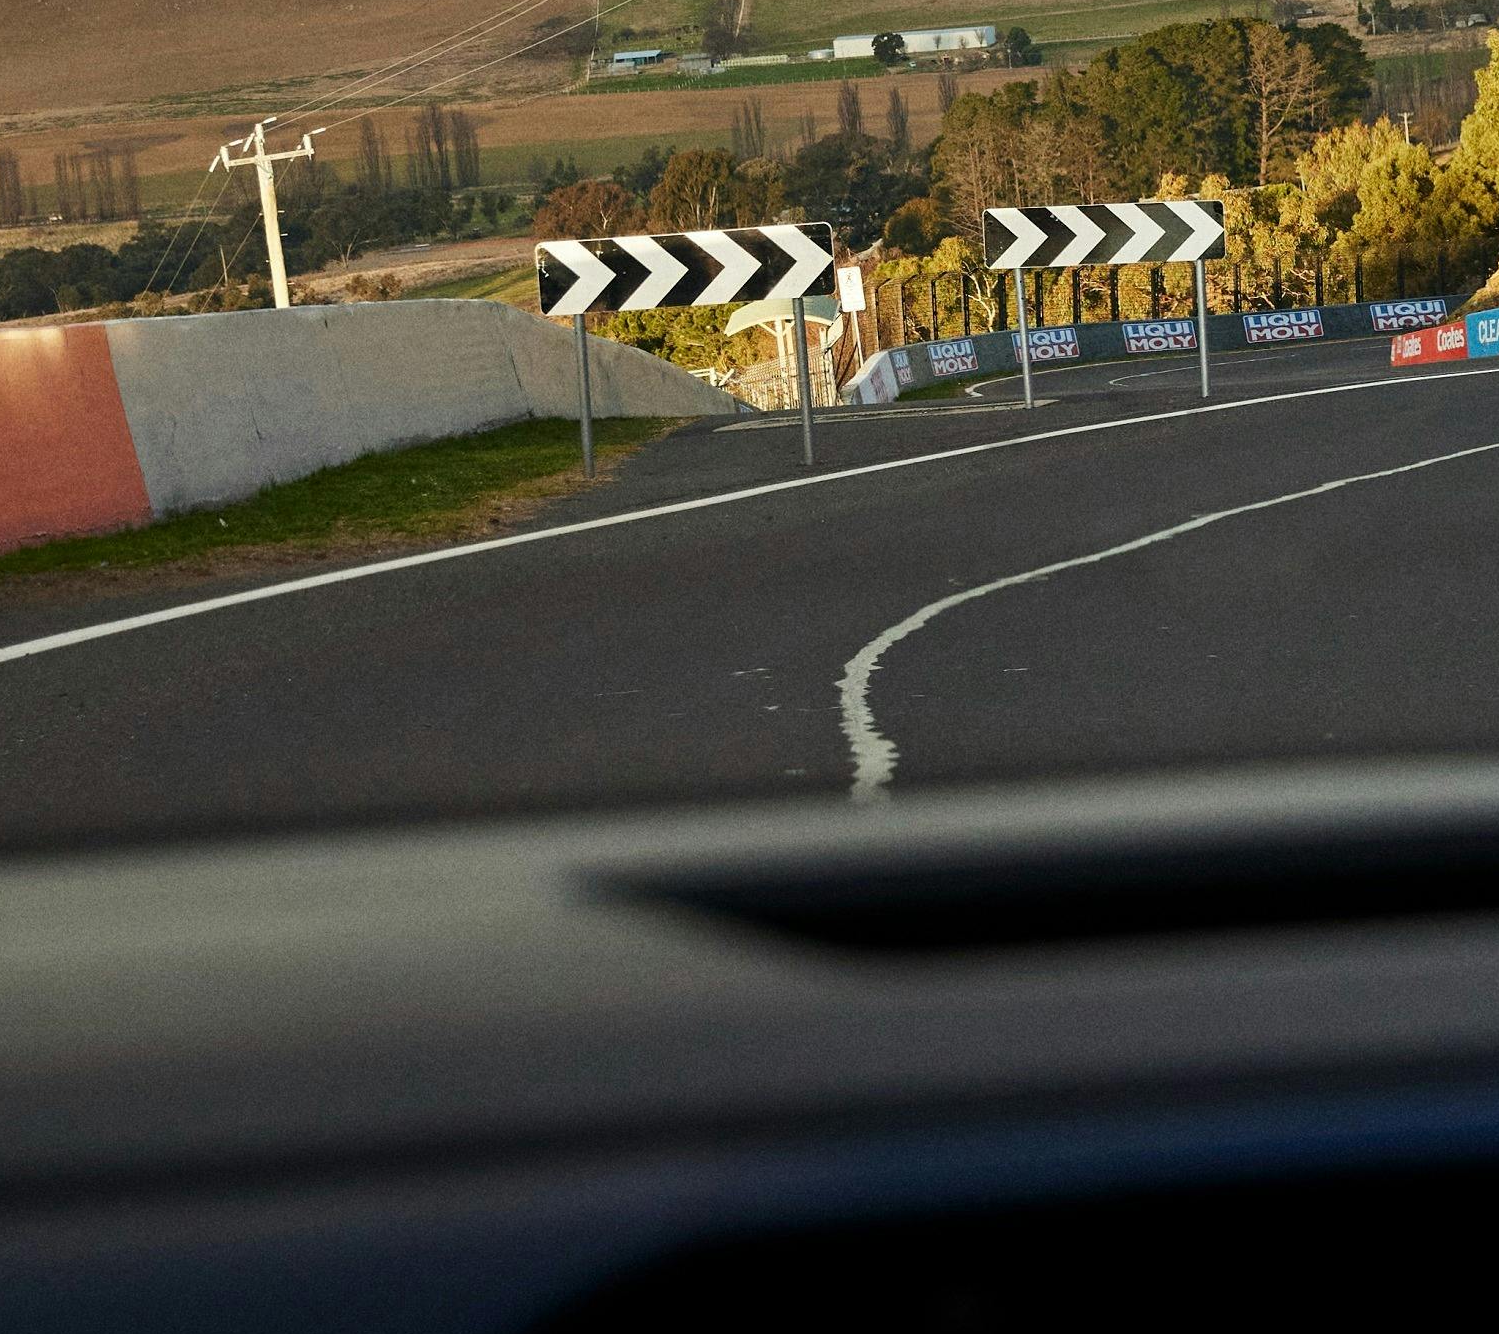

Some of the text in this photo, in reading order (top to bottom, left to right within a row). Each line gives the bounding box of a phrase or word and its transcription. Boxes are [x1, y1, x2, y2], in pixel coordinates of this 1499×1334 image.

[1374, 300, 1441, 317] LIQUI
[1247, 311, 1316, 328] LIQUI
[1377, 313, 1444, 330] MOLY
[1126, 322, 1192, 338] LIQUI
[1250, 323, 1319, 341] MOLY
[1129, 335, 1196, 352] MOLY
[1437, 326, 1464, 352] Coates
[930, 341, 973, 360] LIQUI
[933, 355, 977, 375] MOLY
